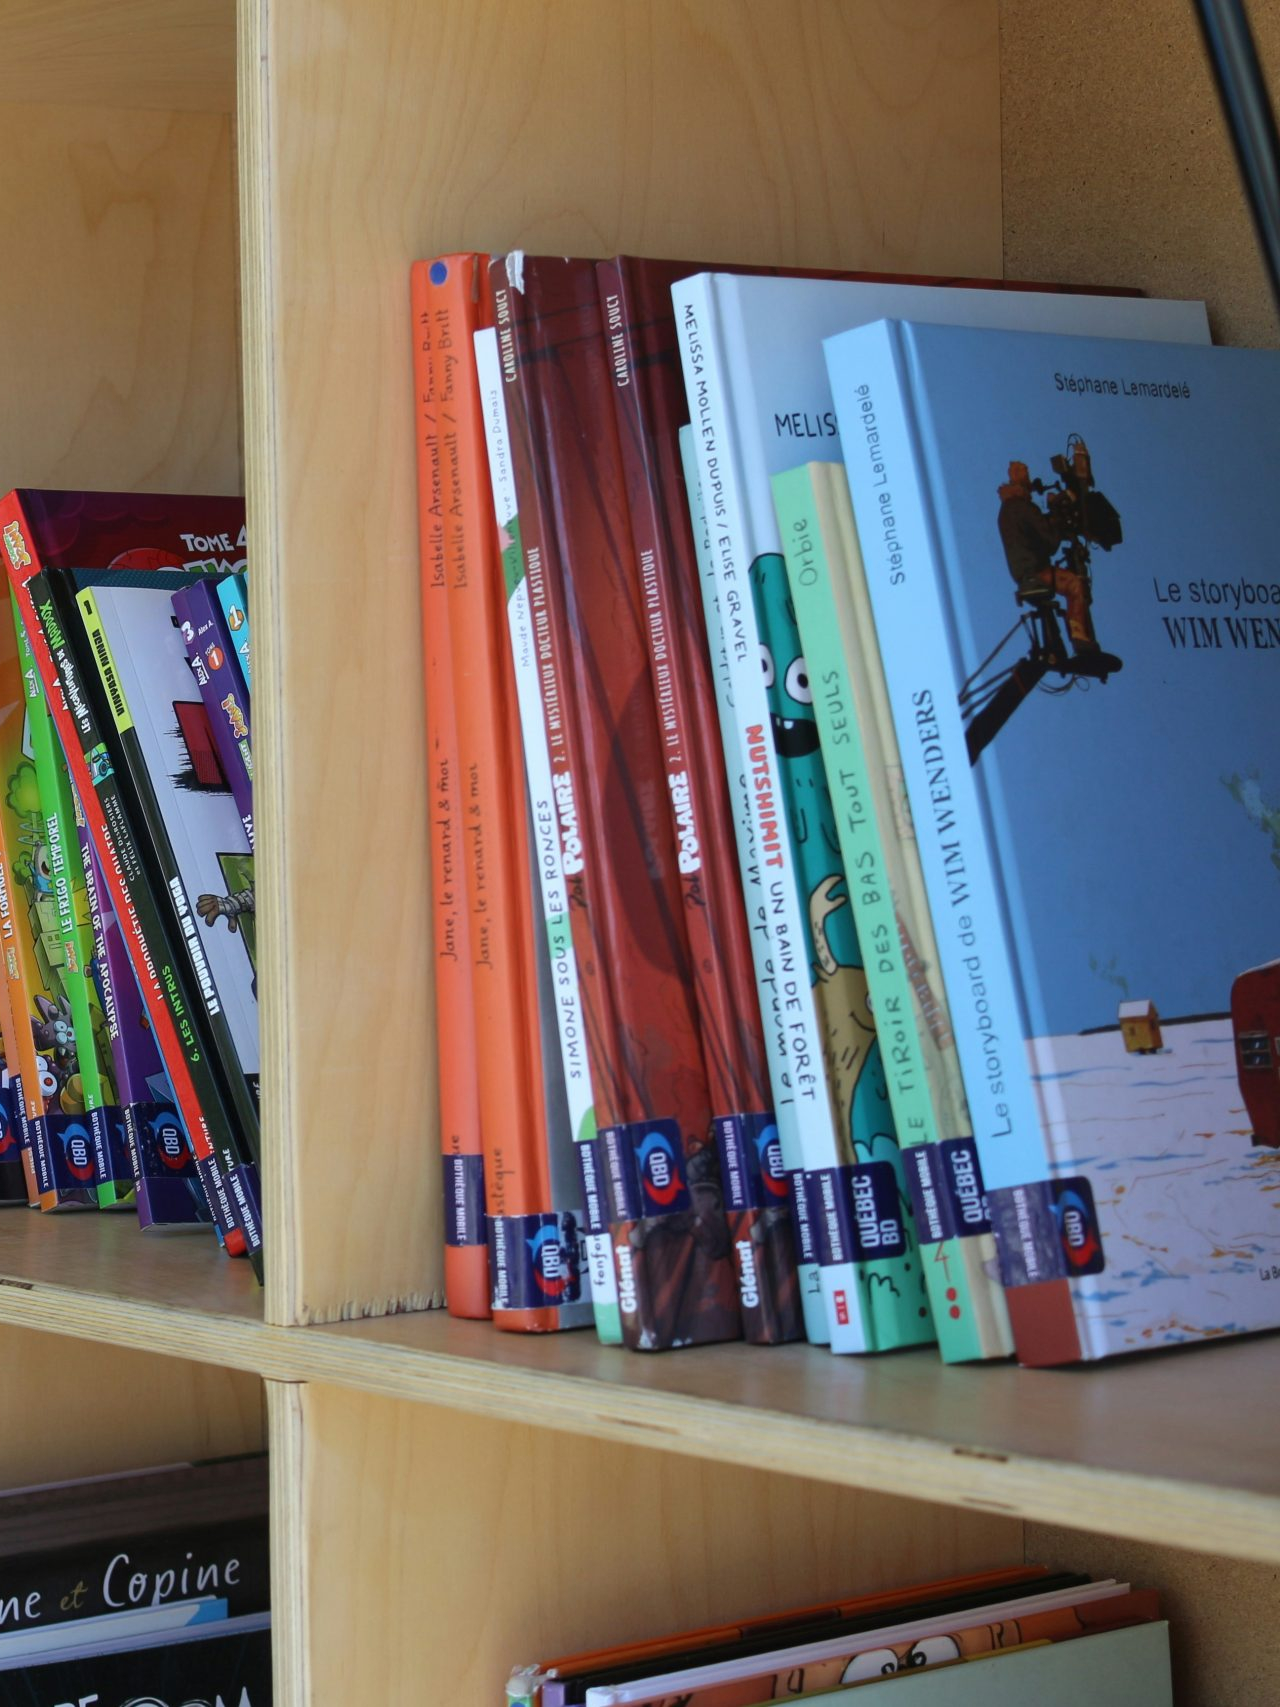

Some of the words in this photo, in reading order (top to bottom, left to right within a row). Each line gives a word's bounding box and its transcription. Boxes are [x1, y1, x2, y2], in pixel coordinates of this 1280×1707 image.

[436, 309, 452, 349] Britt
[495, 289, 510, 325] SOUCY
[606, 294, 623, 330] SOUCY
[441, 355, 459, 402] Fanny
[501, 328, 518, 383] CAROLINE
[611, 332, 629, 387] CAROLINE
[1054, 372, 1119, 397] Stéphane
[1121, 378, 1191, 399] Lemardelé
[490, 390, 502, 433] Dumais
[853, 383, 888, 488] Lemardelé
[425, 432, 444, 517] Arsenault
[444, 430, 466, 517] Arsenault
[496, 436, 508, 482] Sandra
[684, 304, 704, 375] MELISSA
[696, 380, 715, 452] MOLLEN
[707, 458, 727, 517] DUPUIS
[726, 590, 748, 662] GRAVEL
[180, 533, 235, 552] TOME
[430, 524, 445, 589] Isabelle
[452, 527, 468, 590] Isabelle
[793, 518, 818, 586] Orbie
[878, 491, 905, 586] Stéphane
[527, 546, 546, 606] PLASTIQUE
[641, 548, 665, 609] PLASTIQUE
[1152, 576, 1182, 603] Le
[39, 599, 66, 651] MADDOX
[92, 628, 110, 667] NINJA
[519, 624, 530, 668] Maude
[535, 610, 553, 660] DOCTEUR
[650, 611, 667, 659] DOCTEUR
[1162, 616, 1219, 650] WIM
[104, 666, 125, 716] VINYASA
[542, 662, 562, 728] MYSTÉRIEUX
[655, 662, 677, 730] MYSTÉRIEUX
[822, 669, 850, 745] SEULS
[82, 718, 92, 734] LES
[436, 759, 449, 792] moi
[468, 762, 478, 797] moi
[911, 689, 957, 837] WENDERS
[745, 724, 784, 869] NUTSHIMIT
[47, 812, 66, 875] TEMPOREL
[536, 800, 558, 880] RONCES
[552, 771, 584, 876] POLAIRE
[668, 770, 701, 875] POLAIRE
[80, 842, 92, 870] THE
[120, 859, 135, 882] CLAUDE
[436, 818, 453, 887] renard
[467, 825, 484, 893] renard
[941, 840, 972, 908] WIM
[55, 877, 71, 919] FRIGO
[85, 871, 98, 910] BRAIN
[169, 876, 188, 920] YOGA
[440, 891, 453, 905] le
[769, 881, 785, 915] UN
[854, 851, 881, 905] BAS
[62, 924, 73, 933] LE
[92, 913, 102, 931] OF
[474, 900, 487, 915] le
[548, 889, 563, 925] LES
[2, 924, 13, 938] LA
[94, 932, 107, 958] THE
[775, 924, 794, 974] BAIN
[871, 923, 894, 974] DES
[958, 915, 976, 948] de
[188, 940, 216, 1003] POUVOIR
[554, 935, 570, 985] SOUS
[99, 962, 119, 1040] APOCALYPSE
[160, 965, 183, 1015] INTRUS
[208, 1000, 220, 1016] LE
[784, 982, 803, 1013] DE
[180, 1019, 194, 1047] LES
[561, 995, 582, 1079] SIMONE
[962, 954, 1006, 1096] storyboard
[789, 1022, 817, 1100] FORÊT
[162, 1128, 181, 1156] QBD
[990, 1103, 1013, 1139] Le
[39, 1157, 49, 1188] MOBILE
[71, 1139, 88, 1166] QBD
[96, 1149, 107, 1179] MOBILE
[130, 1148, 140, 1178] MOBILE
[208, 1158, 222, 1188] MOBILE
[648, 1152, 669, 1188] QBD
[230, 1174, 244, 1205] MOBILE
[729, 1171, 743, 1206] MOBILE
[949, 1149, 983, 1225] QUÉBEC
[586, 1196, 602, 1230] MOBILE
[851, 1175, 881, 1248] QUÉBEC
[880, 1219, 900, 1246] BD
[1063, 1210, 1084, 1248] QBD
[541, 1242, 558, 1279] QBD
[615, 1244, 637, 1314] Glénat
[735, 1240, 759, 1308] Glénat
[59, 1580, 90, 1612] et
[102, 1551, 242, 1607] Copine
